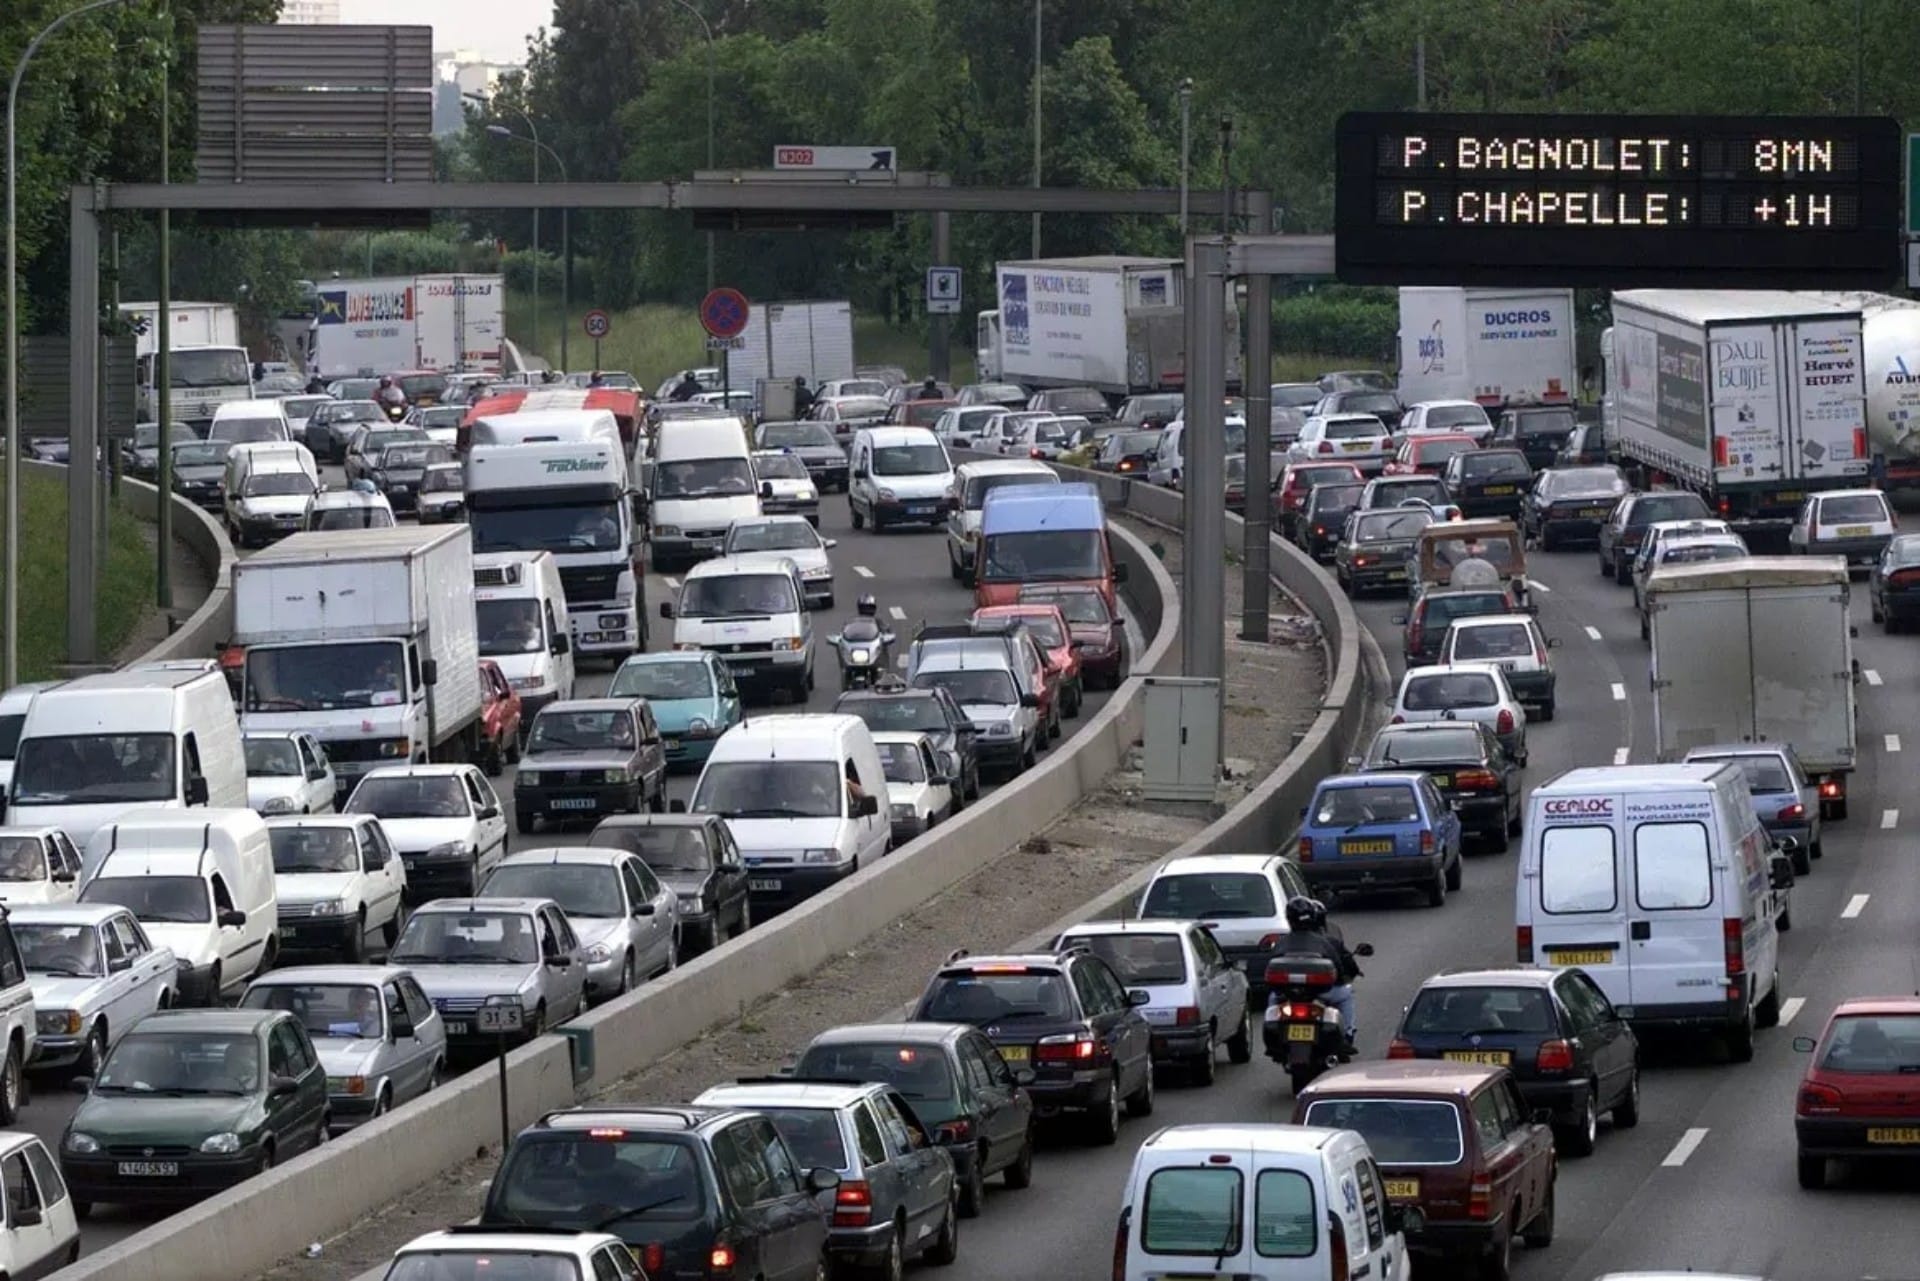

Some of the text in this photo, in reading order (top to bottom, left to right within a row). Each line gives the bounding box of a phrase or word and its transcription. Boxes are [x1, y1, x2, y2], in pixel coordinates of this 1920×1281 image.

[1754, 139, 1832, 172] 8MN
[1754, 193, 1831, 226] +1H
[1485, 310, 1551, 326] DUCROS
[1716, 341, 1769, 366] PAUL
[1804, 358, 1854, 371] Hervé
[1805, 373, 1855, 386] HUET
[1544, 798, 1614, 813] CEMLOC
